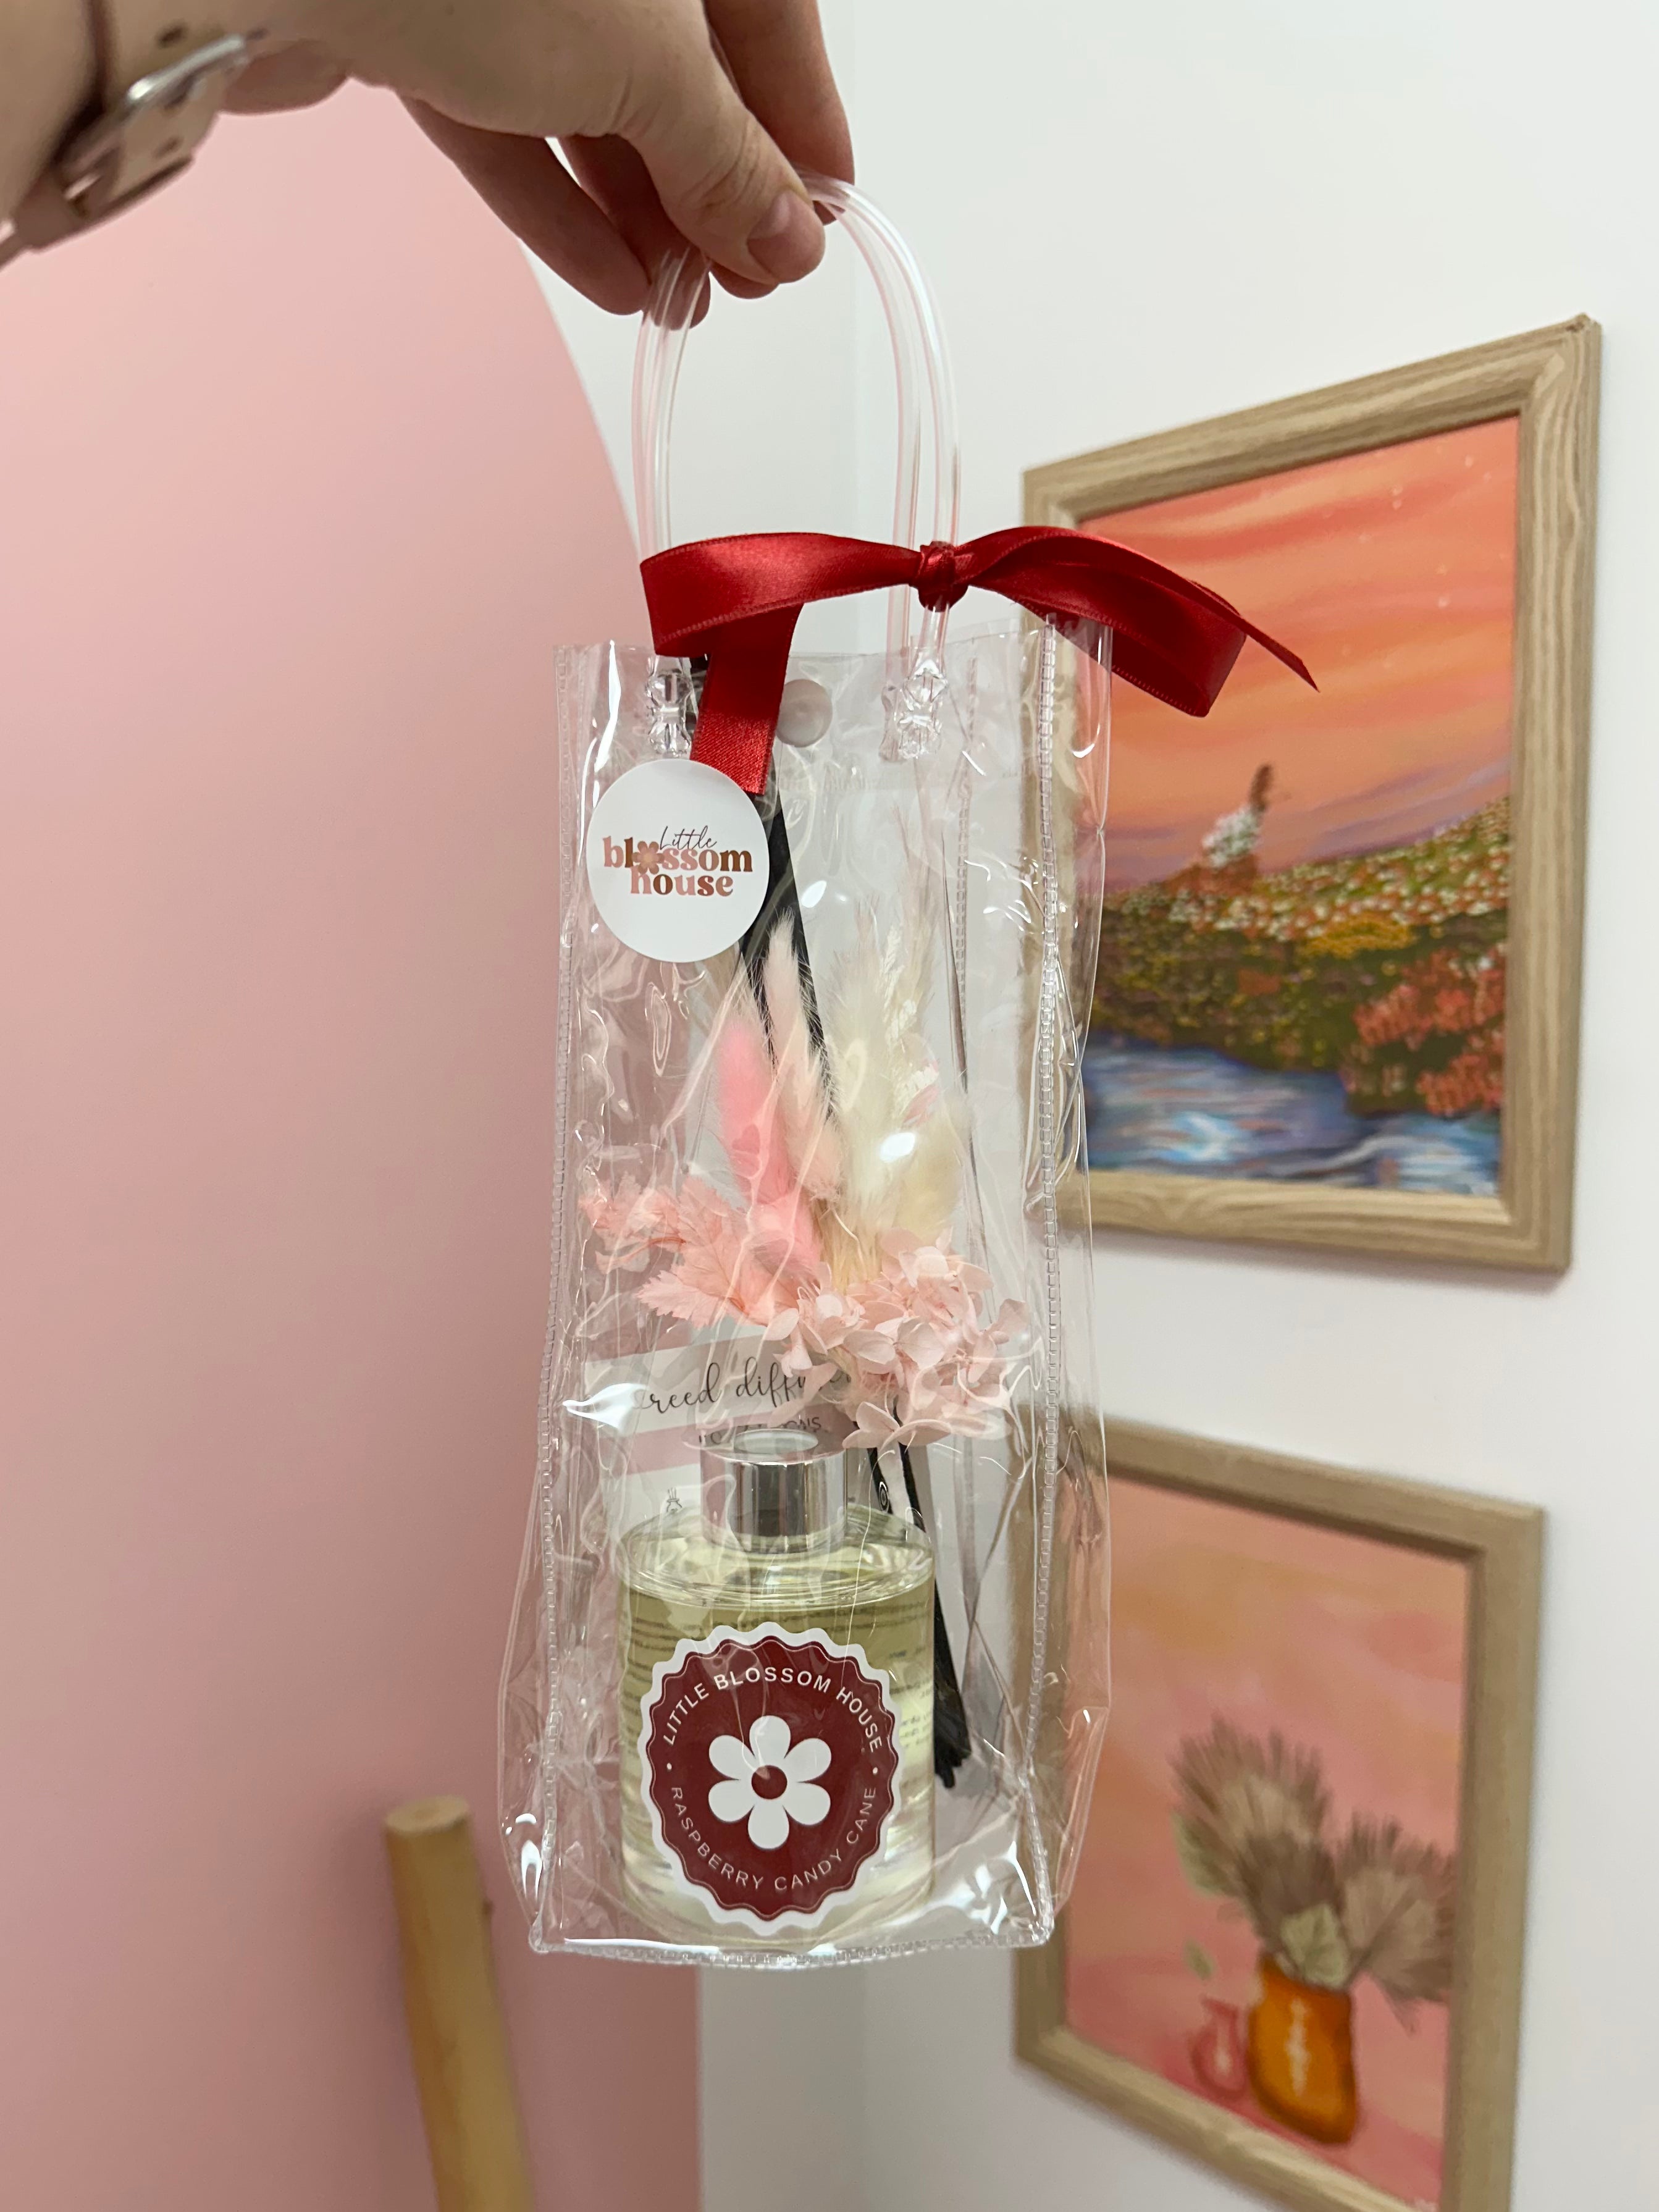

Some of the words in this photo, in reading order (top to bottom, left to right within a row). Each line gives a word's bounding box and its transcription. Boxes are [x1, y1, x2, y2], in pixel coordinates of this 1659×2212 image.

[660, 825, 717, 850] Little
[630, 866, 733, 896] house
[636, 1362, 722, 1414] reed
[663, 1683, 708, 1746] LITTLE
[713, 1667, 831, 1693] BLOSSOM
[836, 1687, 883, 1753] HOUSE
[672, 1787, 763, 1890] RASPBERRY
[775, 1849, 842, 1891] CANDY
[847, 1788, 876, 1844] CANE
